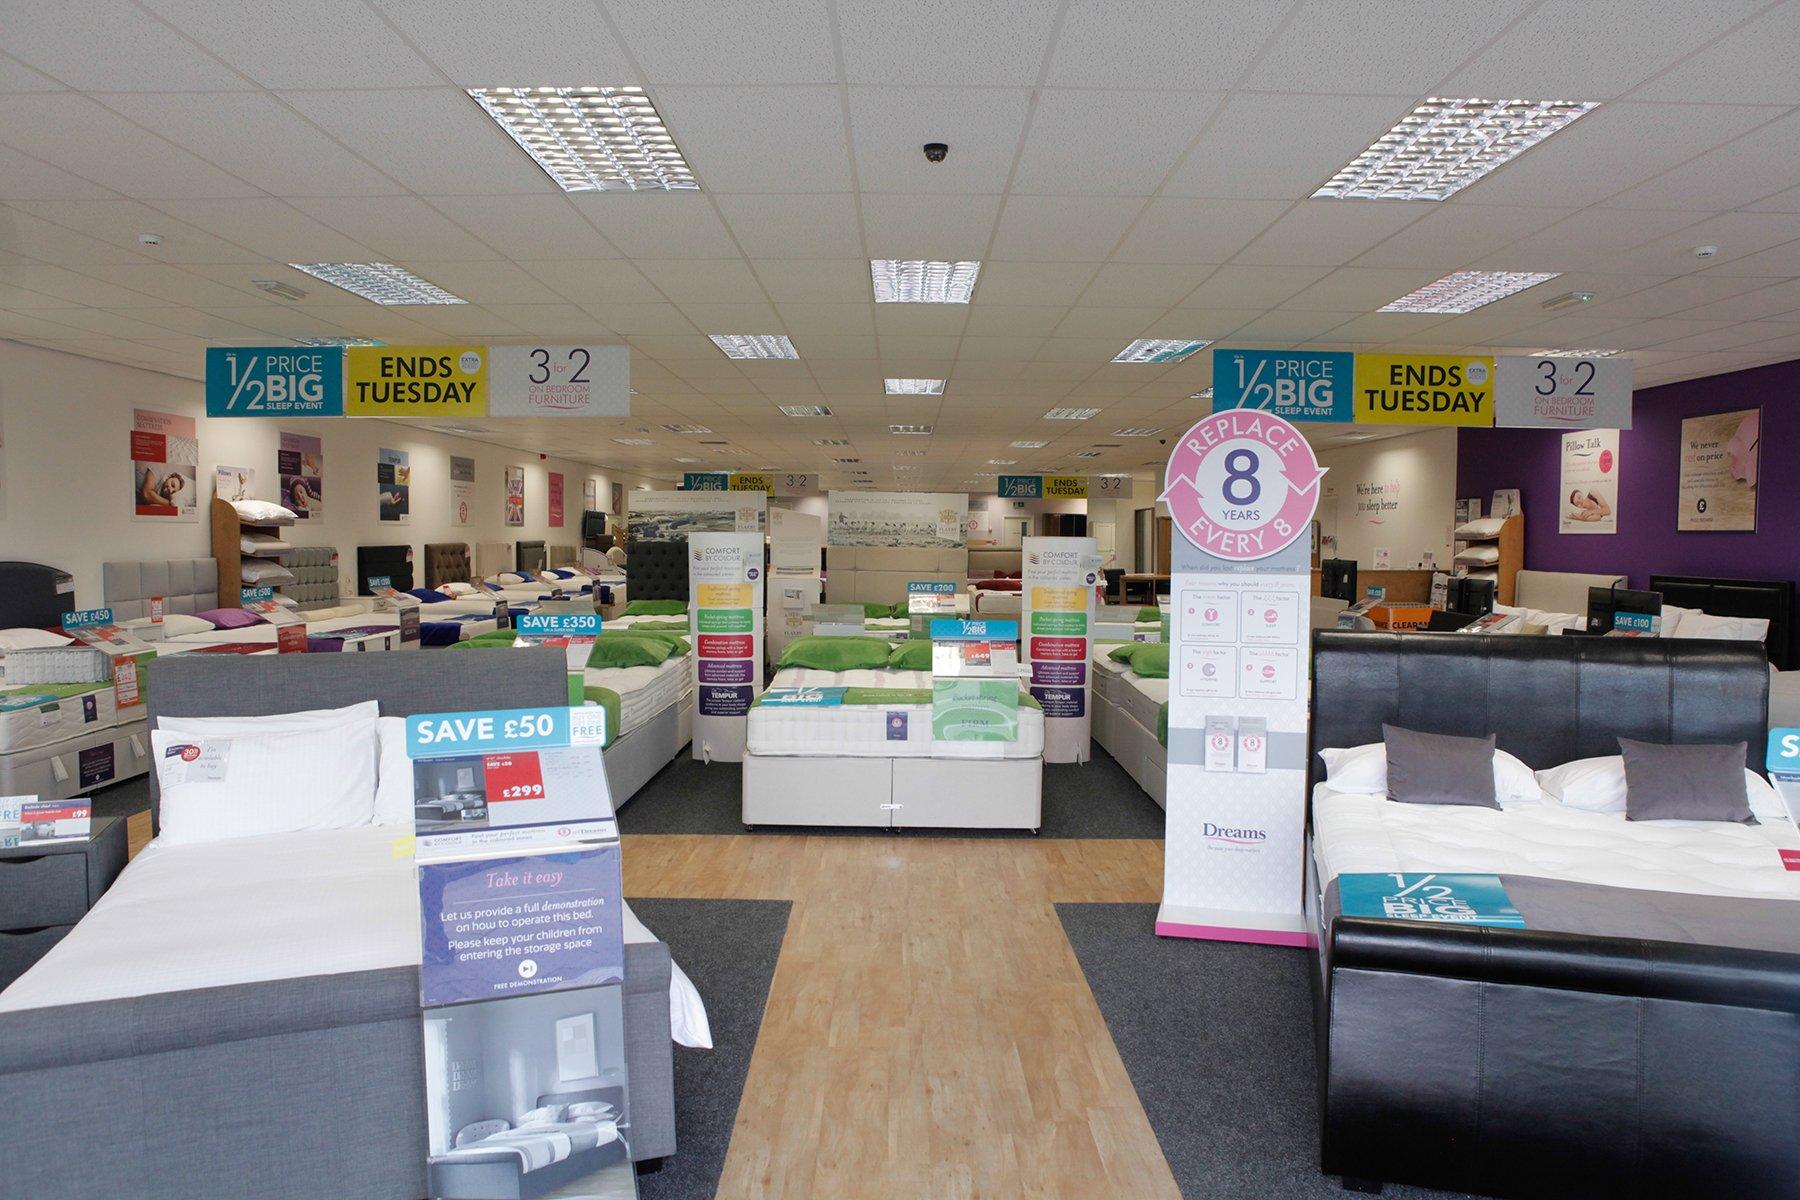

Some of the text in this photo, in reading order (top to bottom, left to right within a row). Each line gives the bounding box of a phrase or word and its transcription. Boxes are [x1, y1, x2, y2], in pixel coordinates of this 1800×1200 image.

[266, 355, 323, 373] PRICE
[381, 356, 453, 378] ENDS
[528, 348, 591, 384] 3 for 2
[1275, 359, 1334, 378] PRICE
[1390, 364, 1462, 387] ENDS
[1535, 360, 1596, 396] 3 for 2
[266, 373, 324, 402] BIG
[356, 381, 477, 403] TUESDAY
[528, 385, 591, 393] ON BEDROOM
[1275, 379, 1334, 407] BIG
[266, 401, 324, 410] SLEEP EVENT
[528, 393, 591, 405] FURNITURE
[1364, 389, 1486, 413] TUESDAY
[1534, 396, 1550, 406] ON
[1275, 407, 1333, 416] SLEEP EVENT
[1533, 405, 1595, 417] FURNITURE
[1186, 416, 1300, 457] REPLACE
[1566, 438, 1601, 452] Pillow Talk
[1690, 441, 1719, 449] We never
[1706, 451, 1724, 463] price
[739, 476, 764, 484] ENDS
[1054, 479, 1078, 487] ENDS
[1222, 448, 1261, 506] 8
[703, 482, 723, 490] BIG
[1017, 484, 1036, 494] BIG
[1046, 487, 1085, 495] TUESDAY
[1222, 510, 1260, 521] YEARS
[1190, 516, 1293, 553] EVERY 8
[705, 547, 740, 555] COMFORT
[1042, 551, 1079, 559] COMFORT
[242, 589, 257, 598] SAVE
[910, 583, 931, 591] SAVE
[66, 609, 110, 624] SAVE £450
[523, 615, 596, 628] SAVE £350
[1615, 615, 1649, 628] SAVE £100
[972, 627, 987, 635] BIG
[417, 717, 495, 744] SAVE
[503, 714, 554, 739] £50
[572, 725, 602, 736] FREE
[503, 784, 543, 798] £299
[72, 809, 88, 818] £99
[1202, 822, 1267, 840] Dreams
[486, 871, 563, 888] Take it easy
[1382, 896, 1469, 907] PRICE
[441, 897, 605, 922] Let us provide a full demonstration
[1382, 903, 1478, 915] BIG
[456, 909, 594, 932] on how to operate this bed.
[448, 924, 603, 950] Please keep your children from
[460, 938, 592, 962] entering the storage space
[509, 975, 563, 988] DEMONSTRATION
